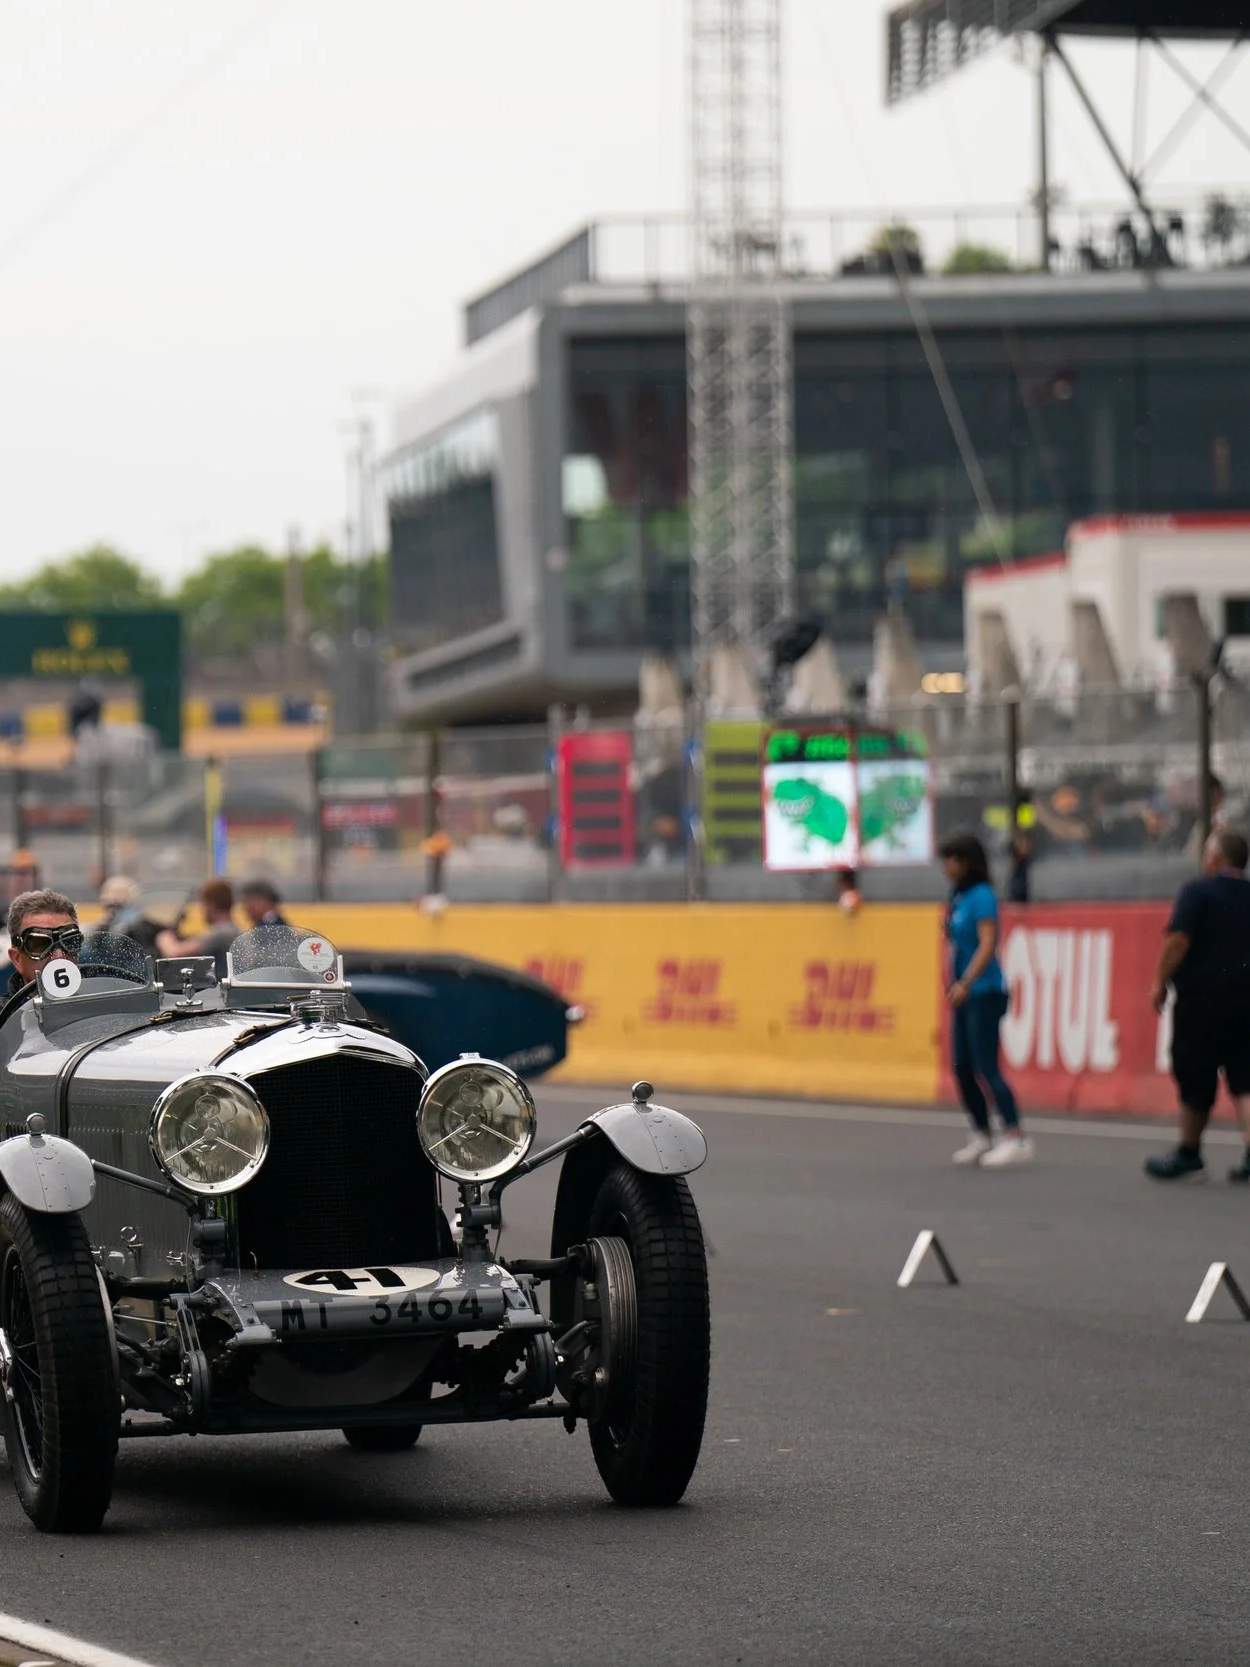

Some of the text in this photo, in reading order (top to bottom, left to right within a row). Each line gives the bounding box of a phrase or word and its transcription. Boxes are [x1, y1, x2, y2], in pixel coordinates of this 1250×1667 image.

[54, 968, 70, 988] 6
[294, 1267, 407, 1291] 41
[280, 1289, 484, 1332] MT 3464
